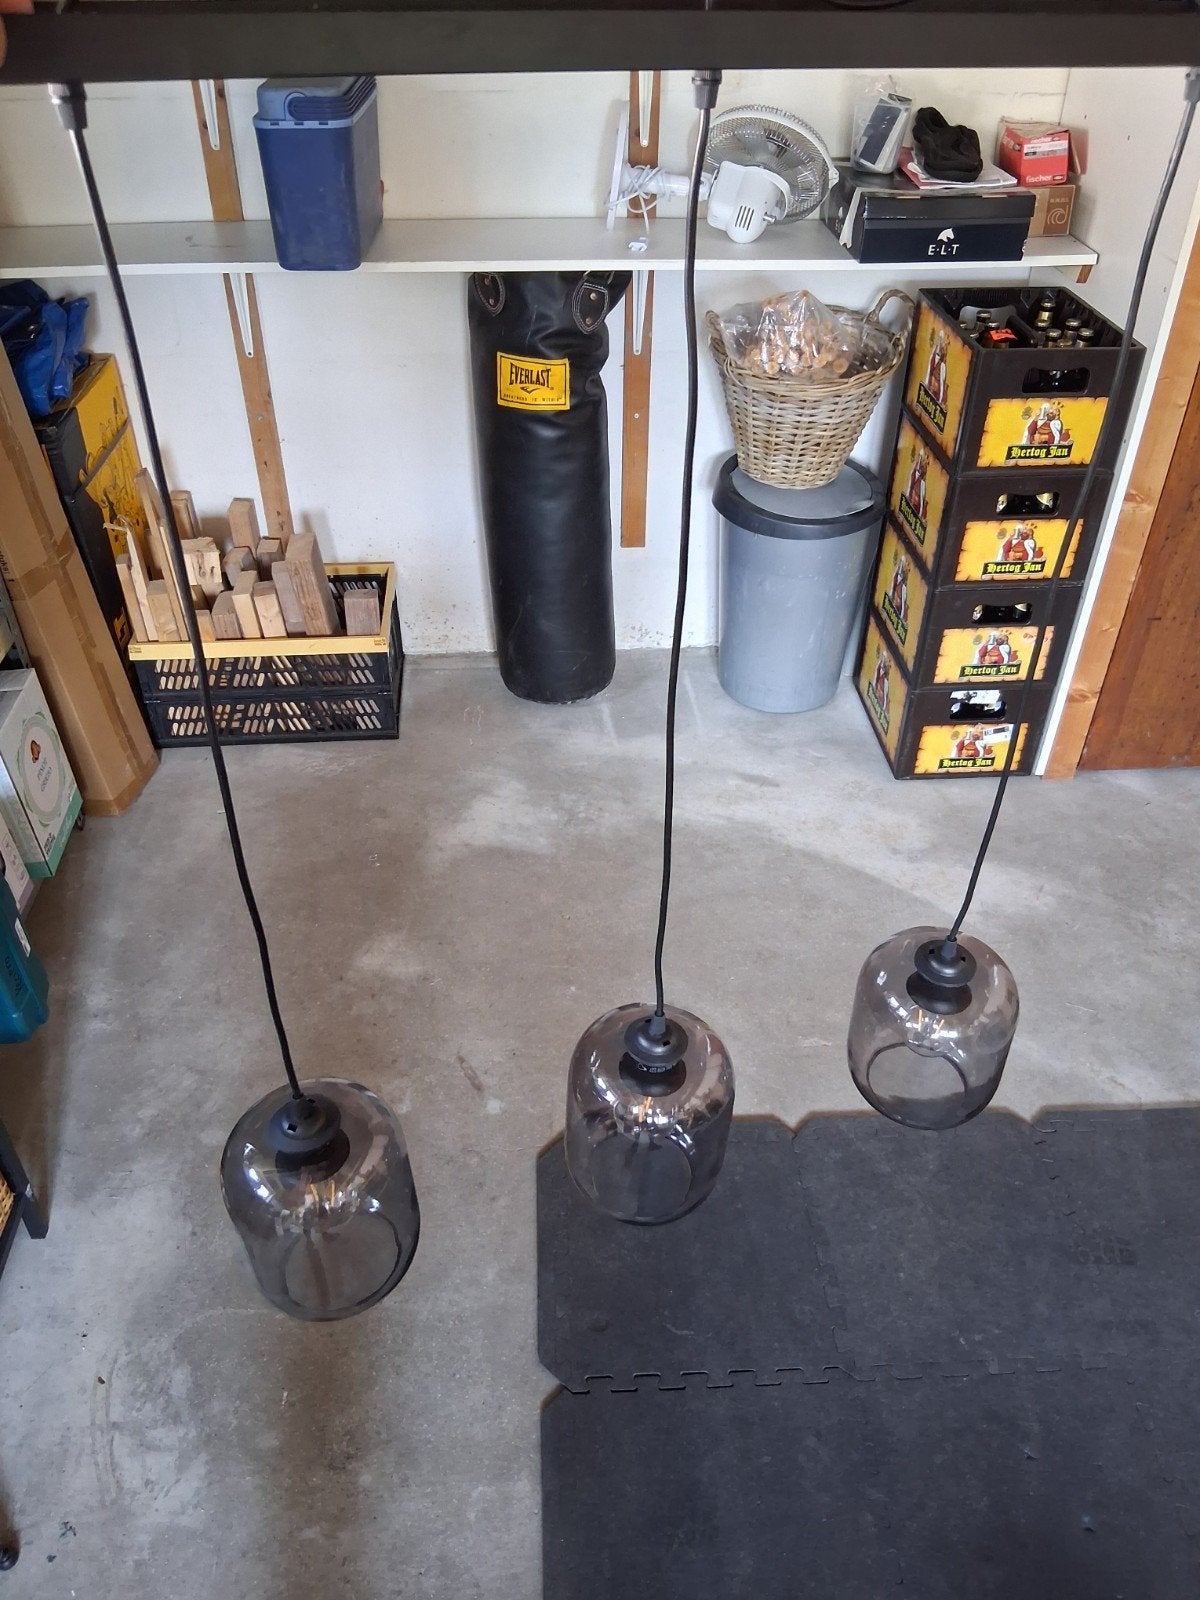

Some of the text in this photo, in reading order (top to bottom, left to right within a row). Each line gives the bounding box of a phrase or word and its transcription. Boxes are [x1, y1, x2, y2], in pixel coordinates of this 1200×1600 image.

[1025, 174, 1052, 184] fischer
[509, 362, 551, 388] EVERLAST
[1010, 446, 1069, 458] Hertog Jan
[987, 562, 1042, 574] Hertog Jan
[964, 665, 1017, 676] Hertog Jan
[942, 759, 974, 768] Hertog
